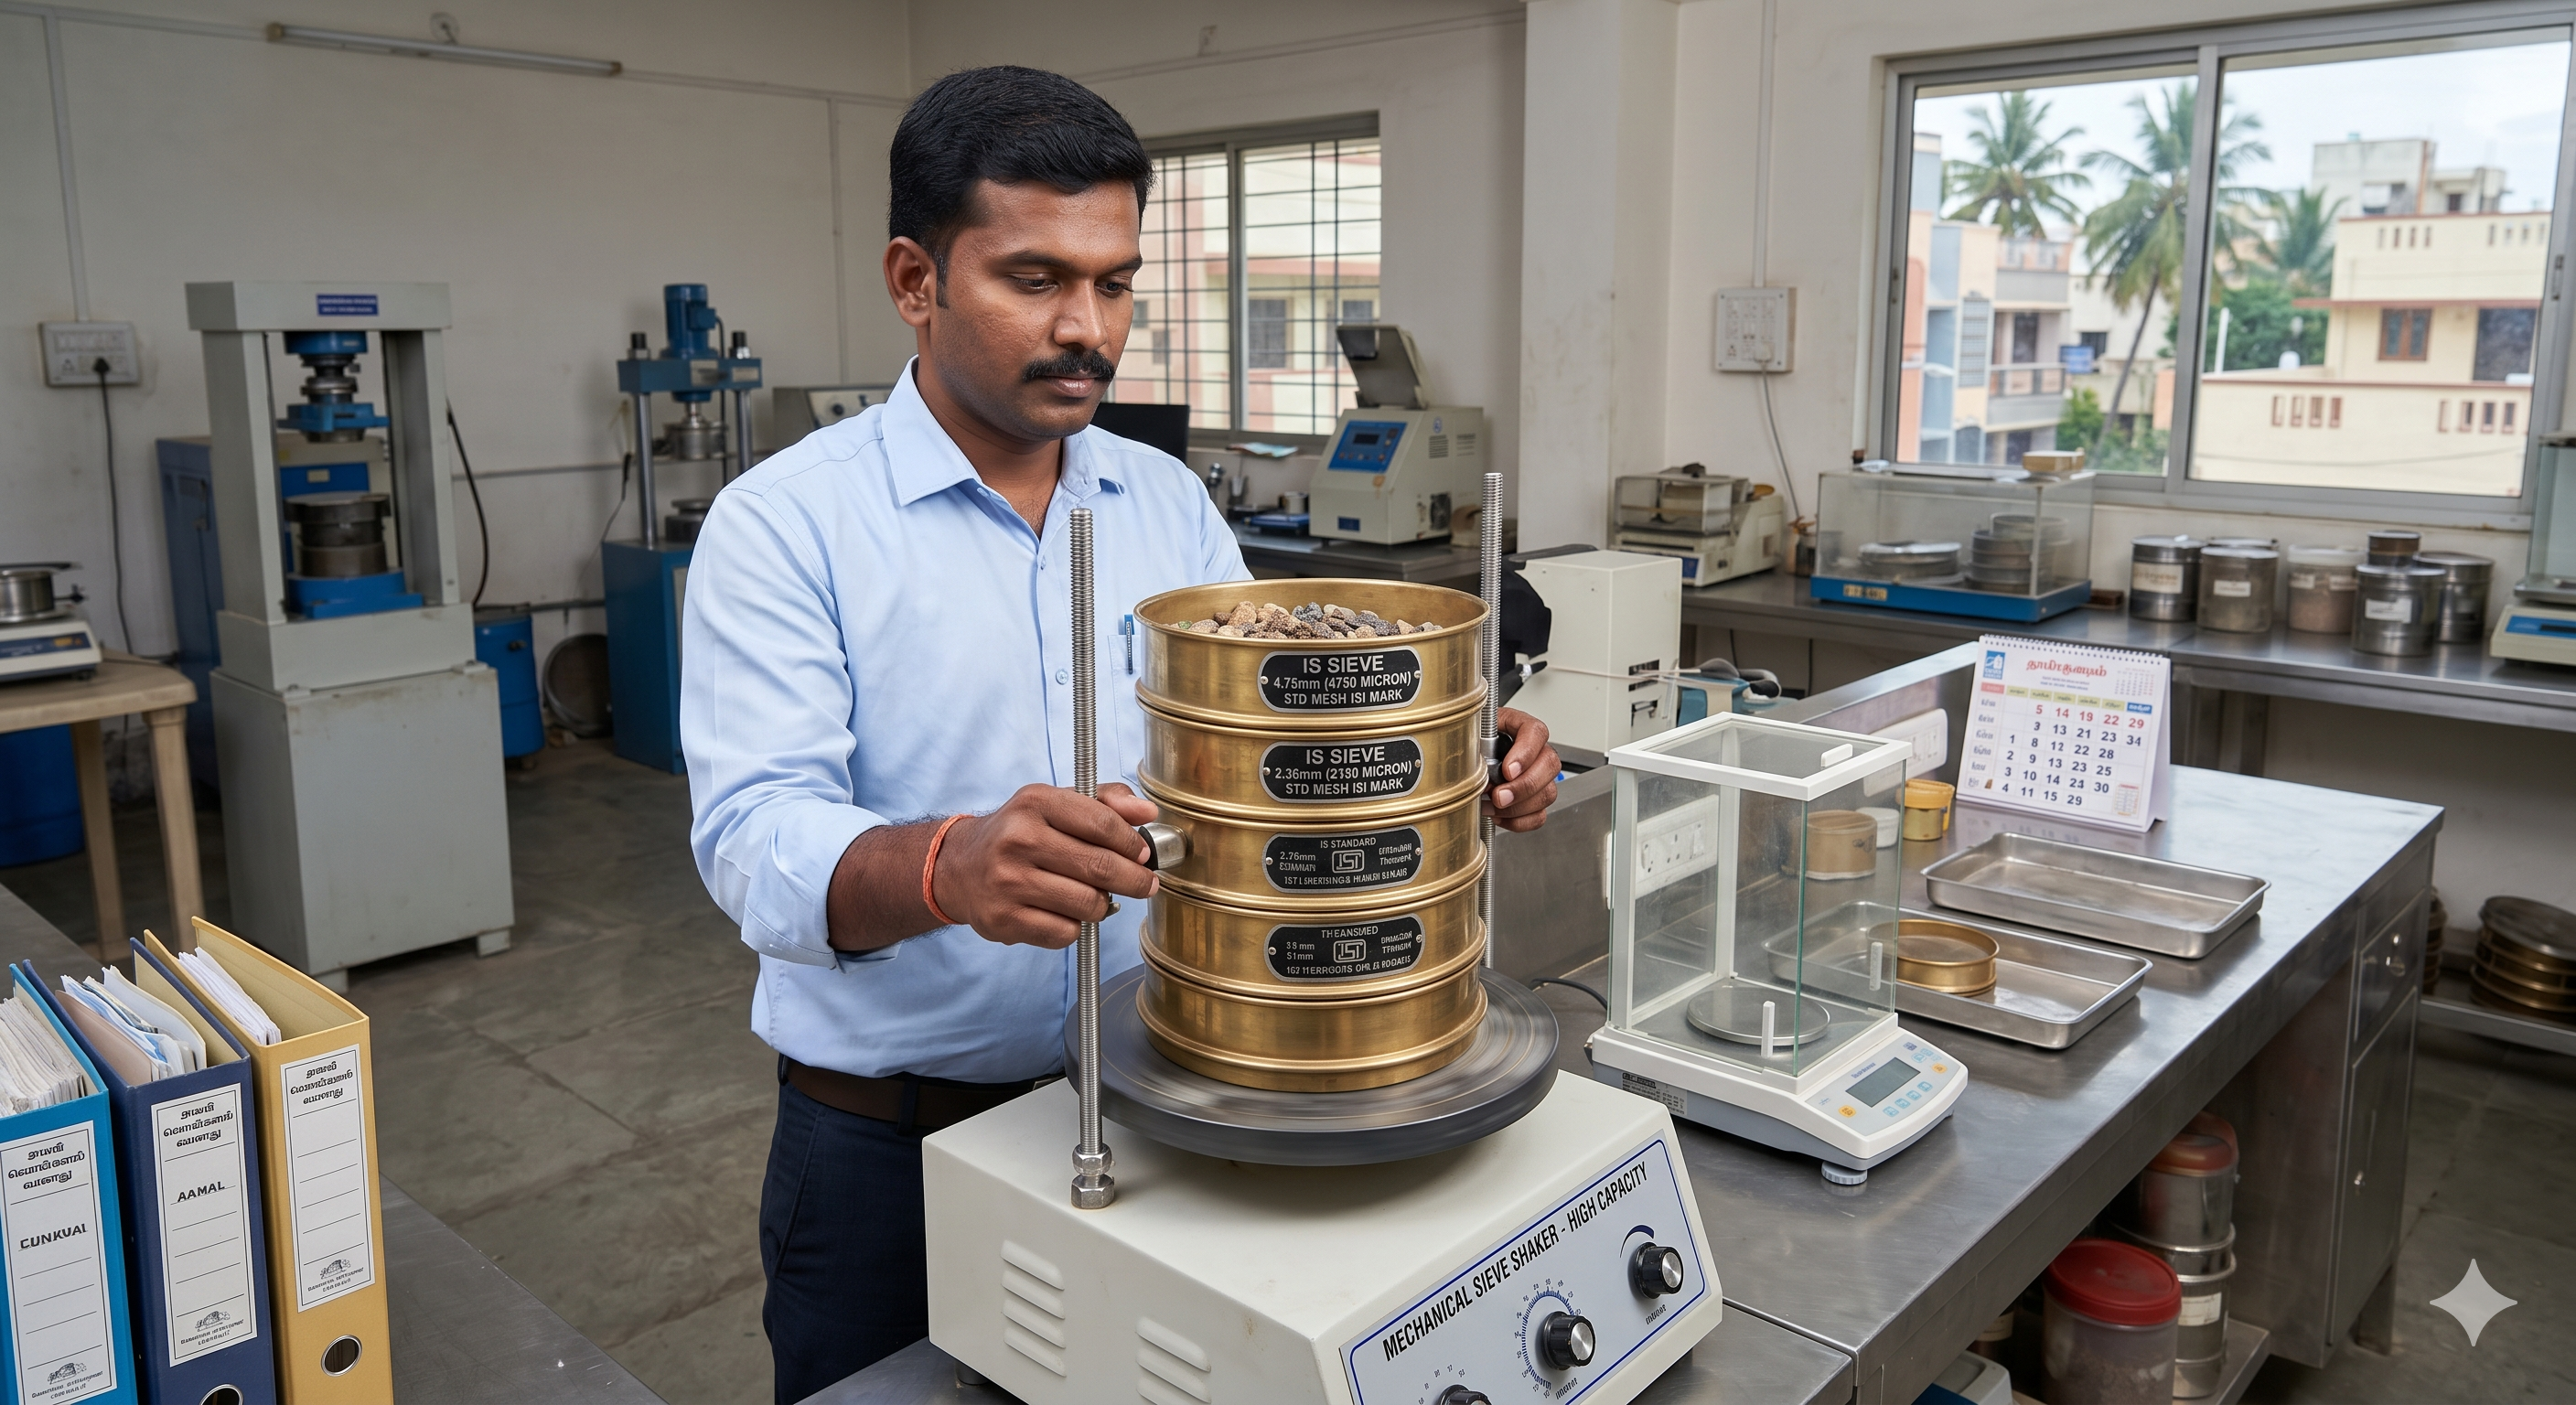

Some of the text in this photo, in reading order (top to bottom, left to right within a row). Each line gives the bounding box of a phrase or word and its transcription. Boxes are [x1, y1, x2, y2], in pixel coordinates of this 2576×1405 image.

[1303, 655, 1384, 674] IS SIEVE
[1273, 670, 1411, 692] 4.75mm (4750 MICRON)
[1284, 689, 1403, 705] STD MESH ISI MARK
[2035, 704, 2044, 714] 5
[2055, 707, 2069, 718] 14
[2103, 713, 2120, 726] 22
[2128, 717, 2144, 729] 29
[2034, 722, 2141, 746] 3 13 21 23 34
[1306, 745, 1385, 765] IS SIEVE
[2009, 735, 2114, 759] 1 8 12 22 28
[1275, 767, 1322, 780] 2.36mm
[1362, 760, 1412, 778] MICRON)
[2006, 750, 2112, 777] 2 9 13 23 25
[1285, 778, 1403, 795] STD MESH ISI MARK
[2004, 767, 2012, 778] 3
[2023, 770, 2037, 781] 10
[2046, 774, 2060, 785] 14
[2094, 782, 2109, 794] 30
[2002, 783, 2083, 806] 4 11 15 29
[1320, 837, 1377, 849] IS STANDARD
[1280, 852, 1316, 861] 2.76mm
[177, 1181, 225, 1203] AAMAL
[1382, 1285, 1473, 1362] MECHANICAL
[1473, 1257, 1511, 1298] SIEVE
[1510, 1224, 1560, 1271] SHAKER
[1566, 1196, 1598, 1233] HIGH
[1596, 1161, 1648, 1211] CAPACITY
